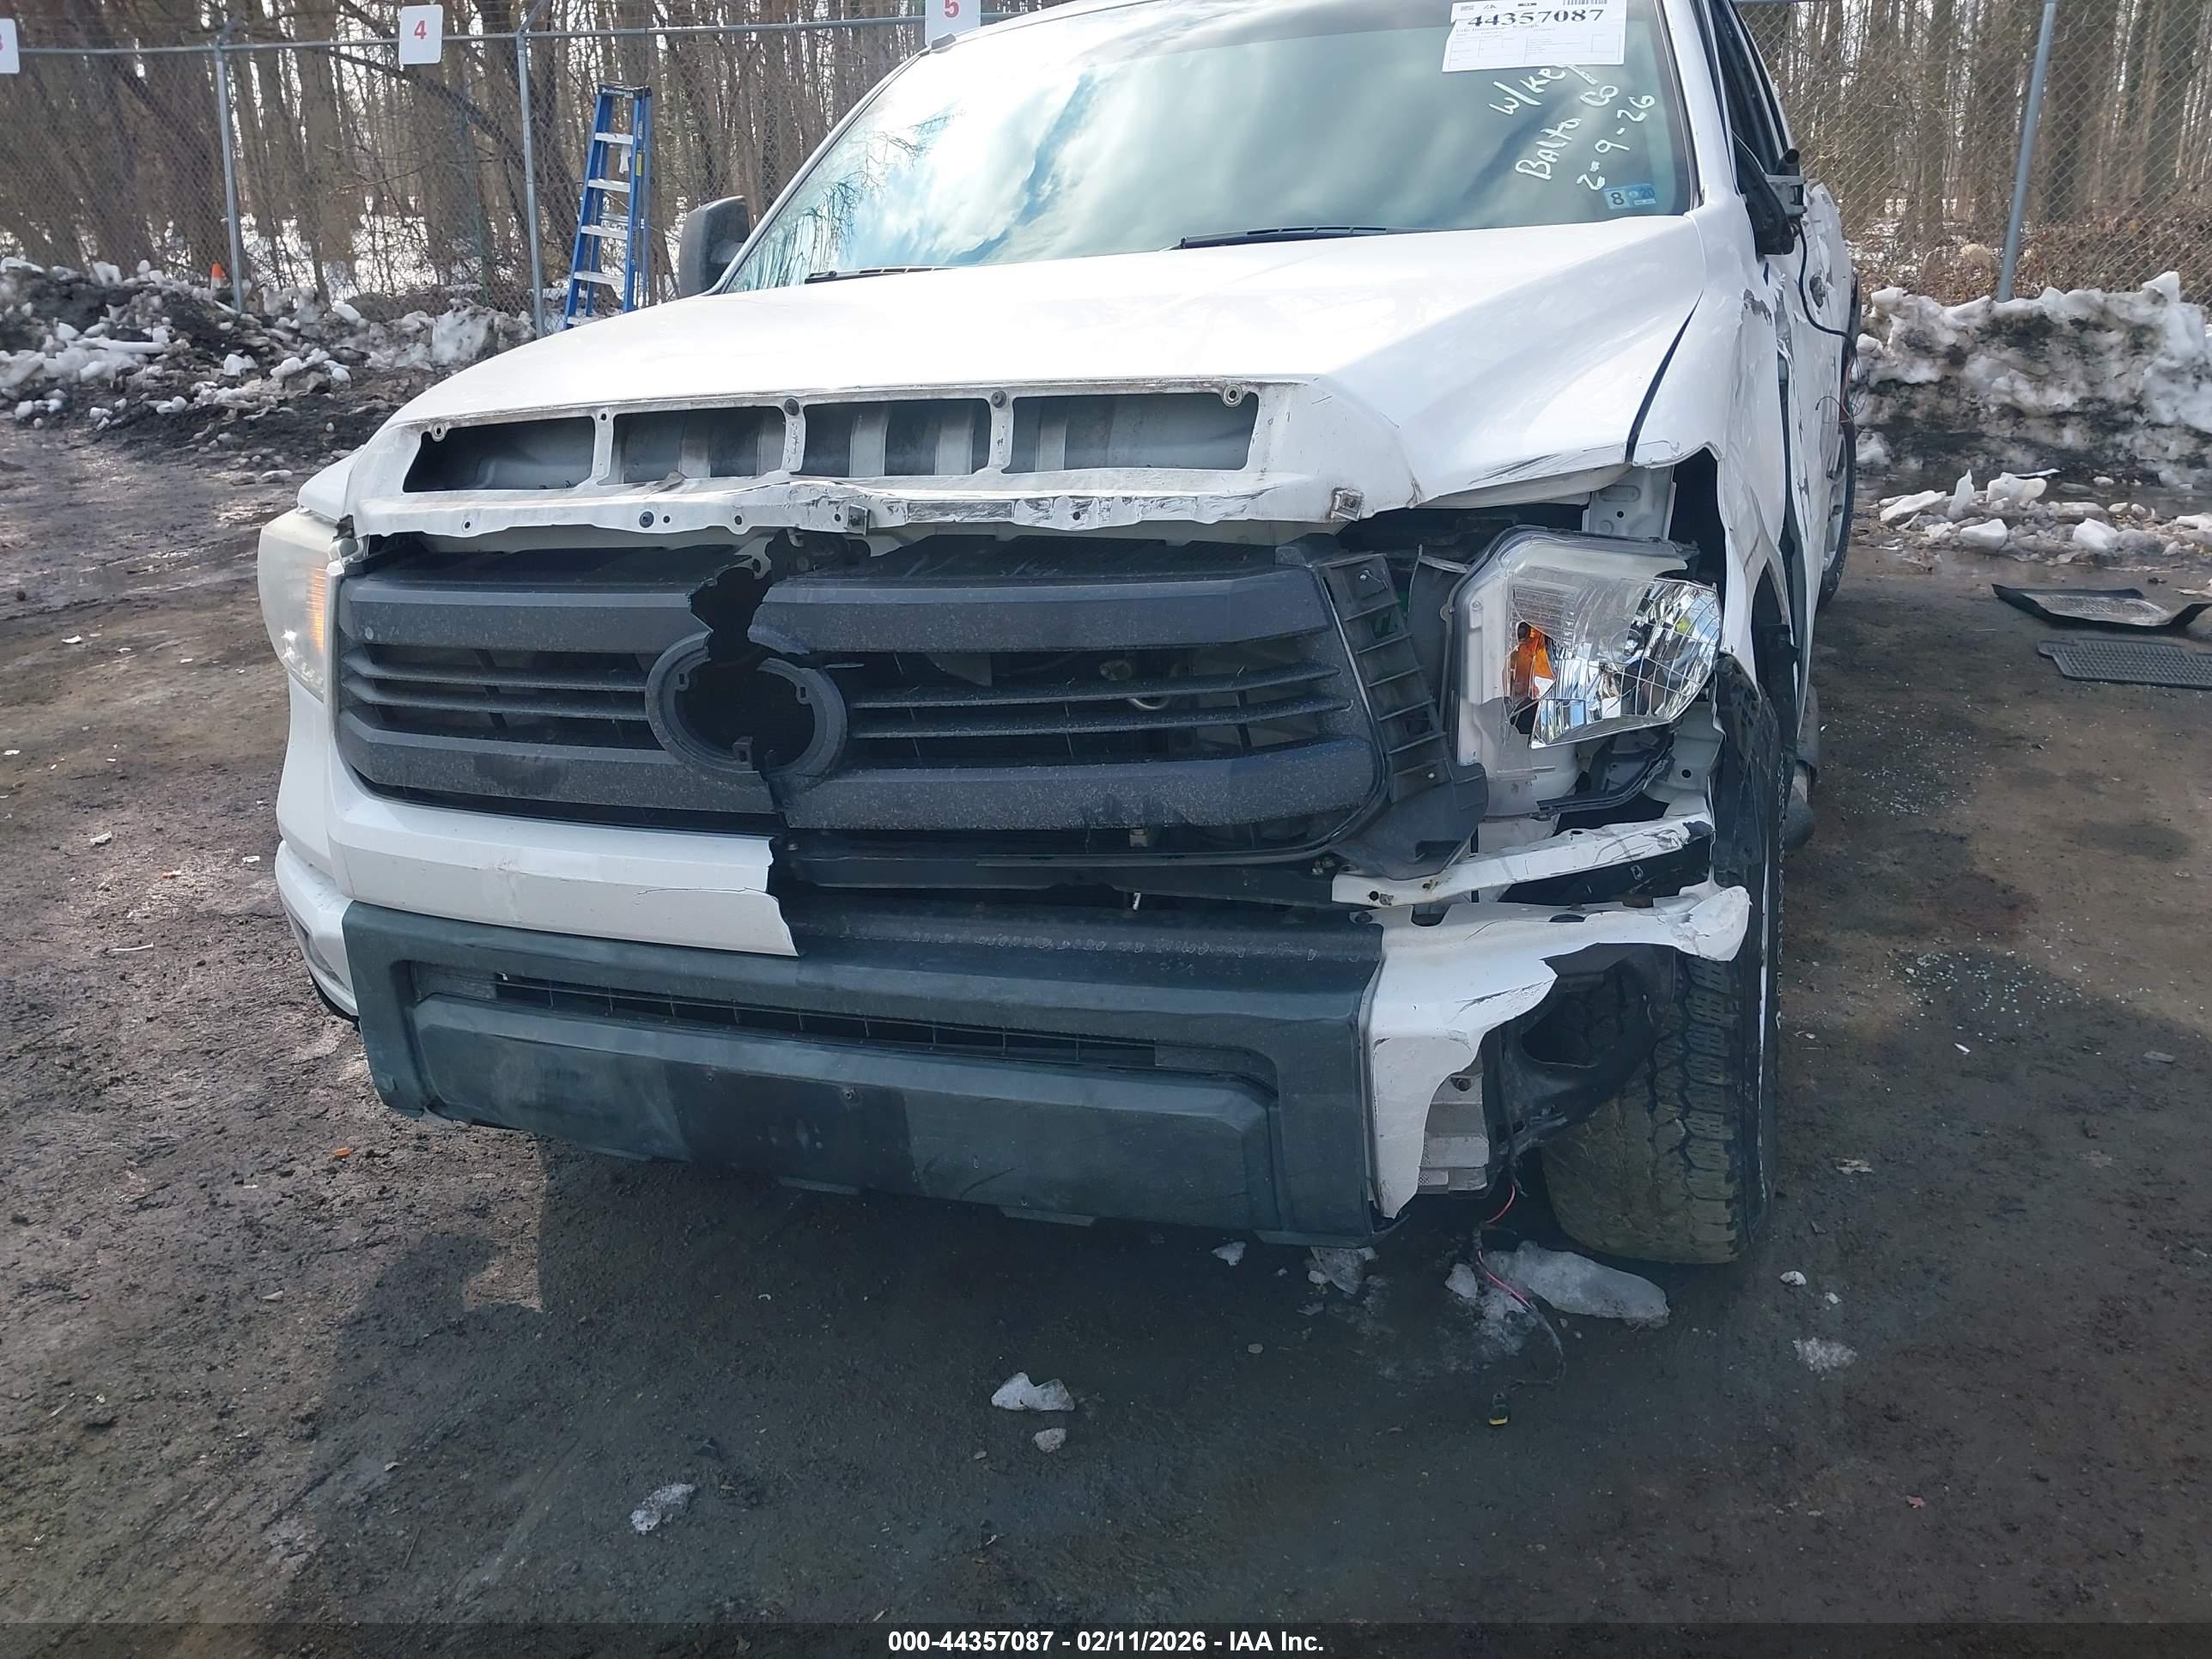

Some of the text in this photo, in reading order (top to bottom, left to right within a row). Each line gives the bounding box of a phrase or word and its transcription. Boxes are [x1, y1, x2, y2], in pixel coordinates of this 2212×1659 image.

[945, 0, 959, 18] 5
[1467, 9, 1604, 27] 44357087
[414, 20, 427, 40] 4
[1610, 191, 1625, 205] 8
